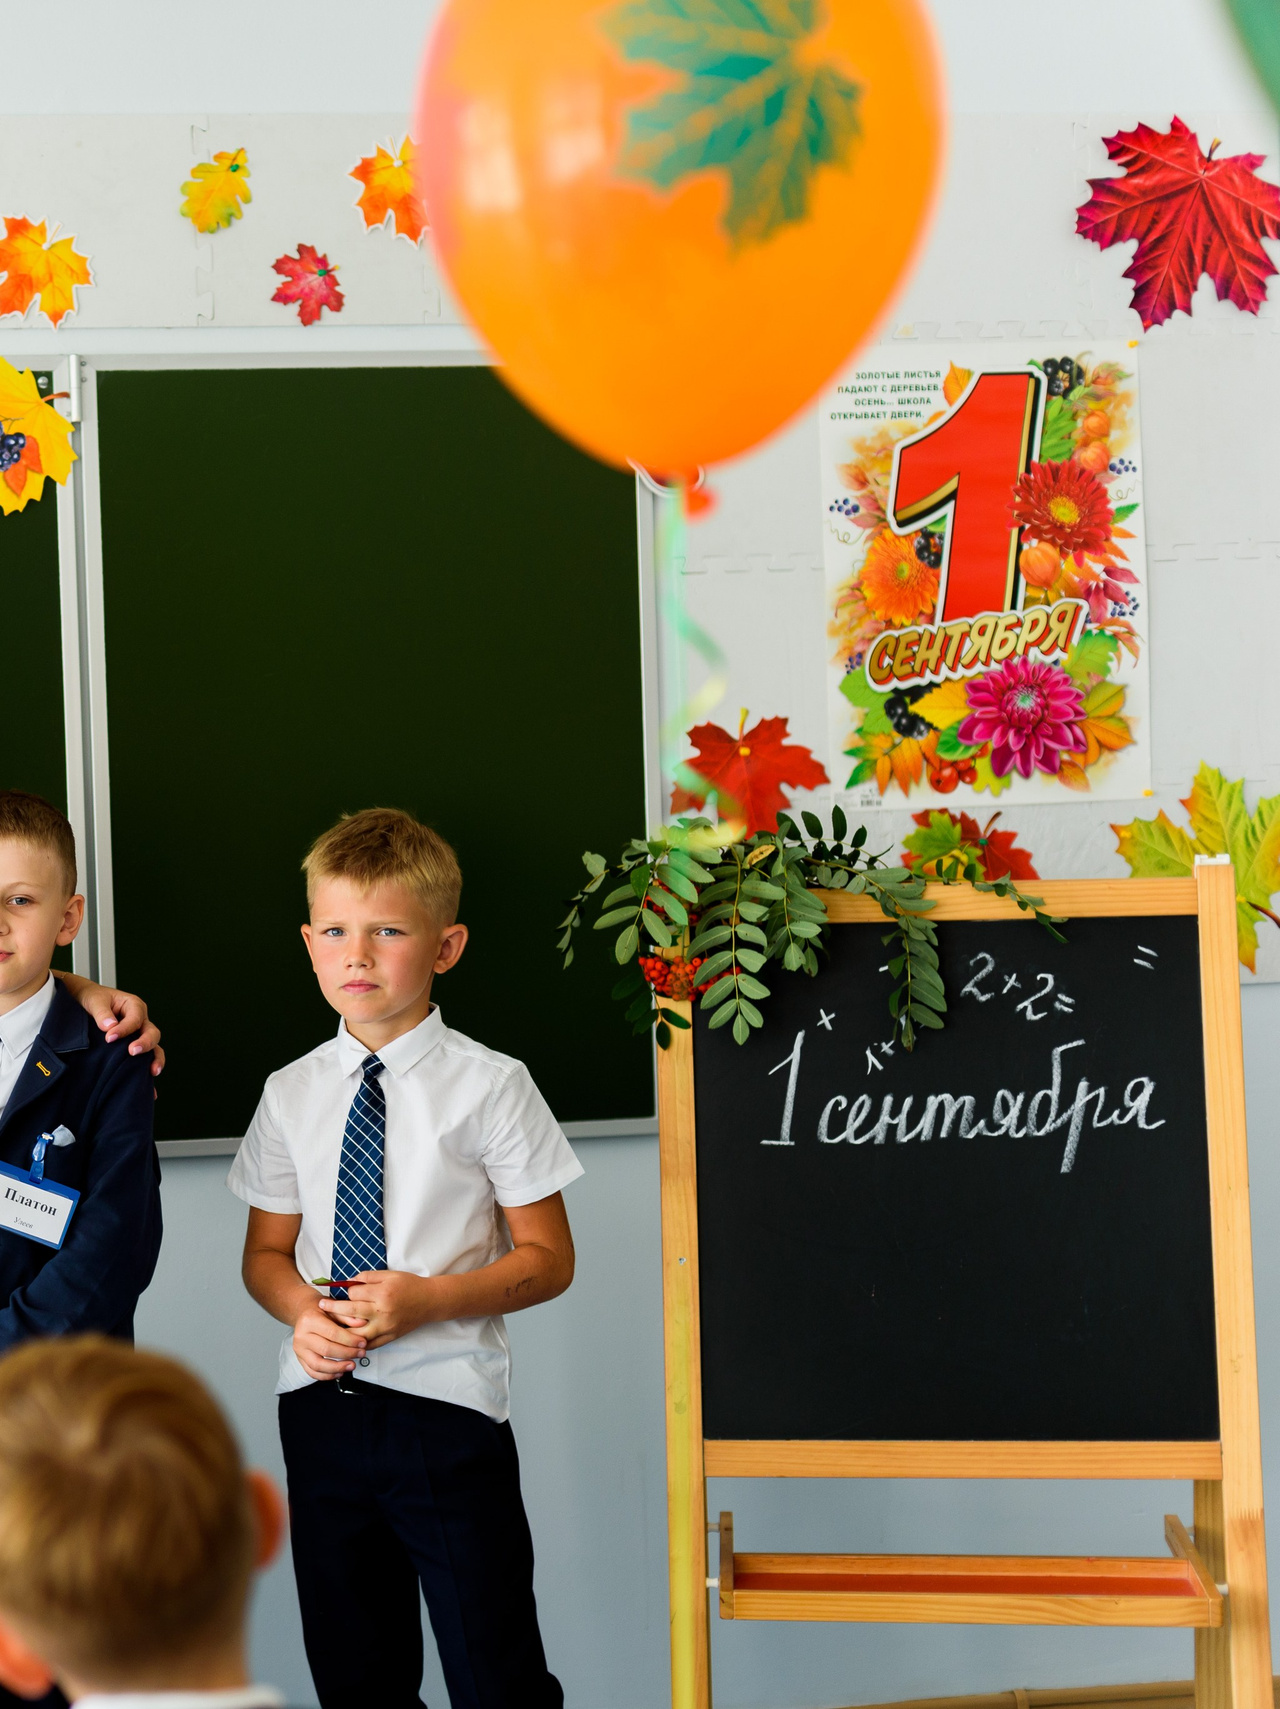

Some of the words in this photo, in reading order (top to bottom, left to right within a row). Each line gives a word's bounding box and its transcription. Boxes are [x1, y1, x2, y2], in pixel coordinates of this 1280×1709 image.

[855, 371, 901, 380] ЗОЛОТЫЕ
[904, 370, 941, 379] ЛИСТЬЯ
[837, 385, 878, 394] ПАДАЮТ
[881, 385, 887, 393] С
[890, 383, 942, 393] ДЕРЕВЬЕВ.
[854, 398, 895, 406] ОСЕНЬ...
[897, 397, 932, 405] ШКОЛА
[830, 411, 887, 420] ОТКРЫВАЕТ
[890, 411, 924, 420] ДВЕРИ.
[894, 371, 1039, 622] 1
[870, 602, 1082, 684] СЕНТЯБРЯ
[760, 1029, 805, 1146] 1
[818, 1039, 1166, 1174] сентября
[4, 1187, 58, 1216] Платон
